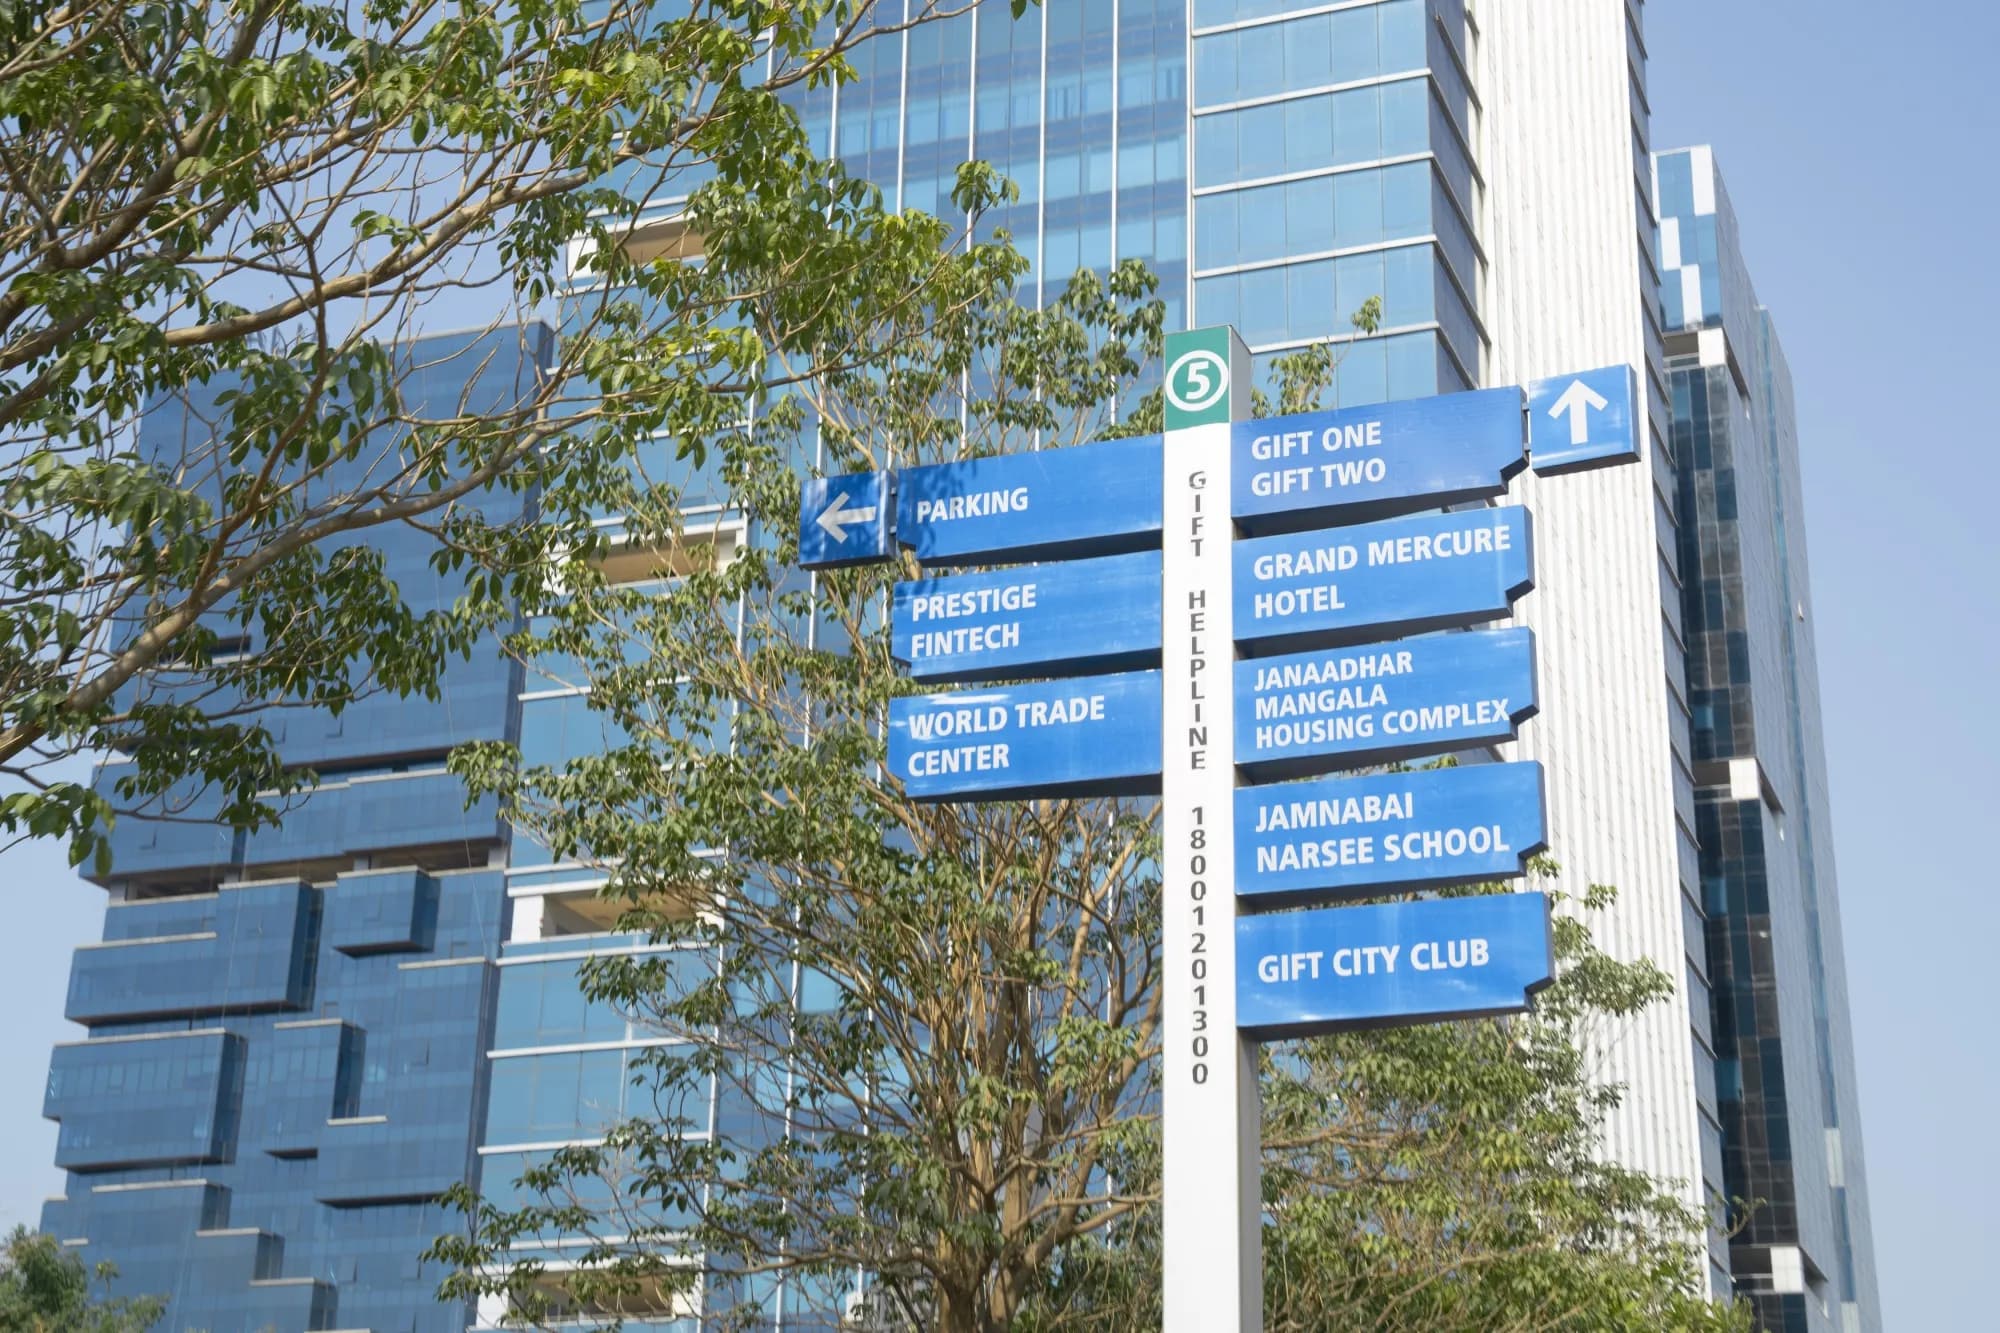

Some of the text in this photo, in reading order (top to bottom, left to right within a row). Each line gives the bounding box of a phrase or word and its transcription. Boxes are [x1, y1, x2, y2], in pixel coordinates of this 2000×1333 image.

[1186, 361, 1210, 399] 5
[1250, 421, 1382, 461] GIFT ONE
[1251, 457, 1386, 497] GIFT TWO
[917, 487, 1029, 524] PARKING
[1253, 525, 1512, 580] GRAND MERCURE
[912, 584, 1037, 621] PRESTIGE
[1255, 585, 1345, 618] HOTEL
[911, 623, 1020, 658] FINTECH
[1254, 651, 1414, 691] JANAADHAR
[908, 695, 1106, 739] WORLD TRADE
[1255, 684, 1389, 720] MANGALA
[1256, 698, 1512, 750] HOUSING COMPLEX
[908, 744, 1010, 777] CENTER
[1188, 471, 1209, 1085] GIFT HELPLINE 18001201300
[1255, 792, 1414, 832] JAMNABAI
[1257, 825, 1511, 873] NARSEE SCHOOL
[1257, 938, 1489, 983] GIFT CITY CLUB
